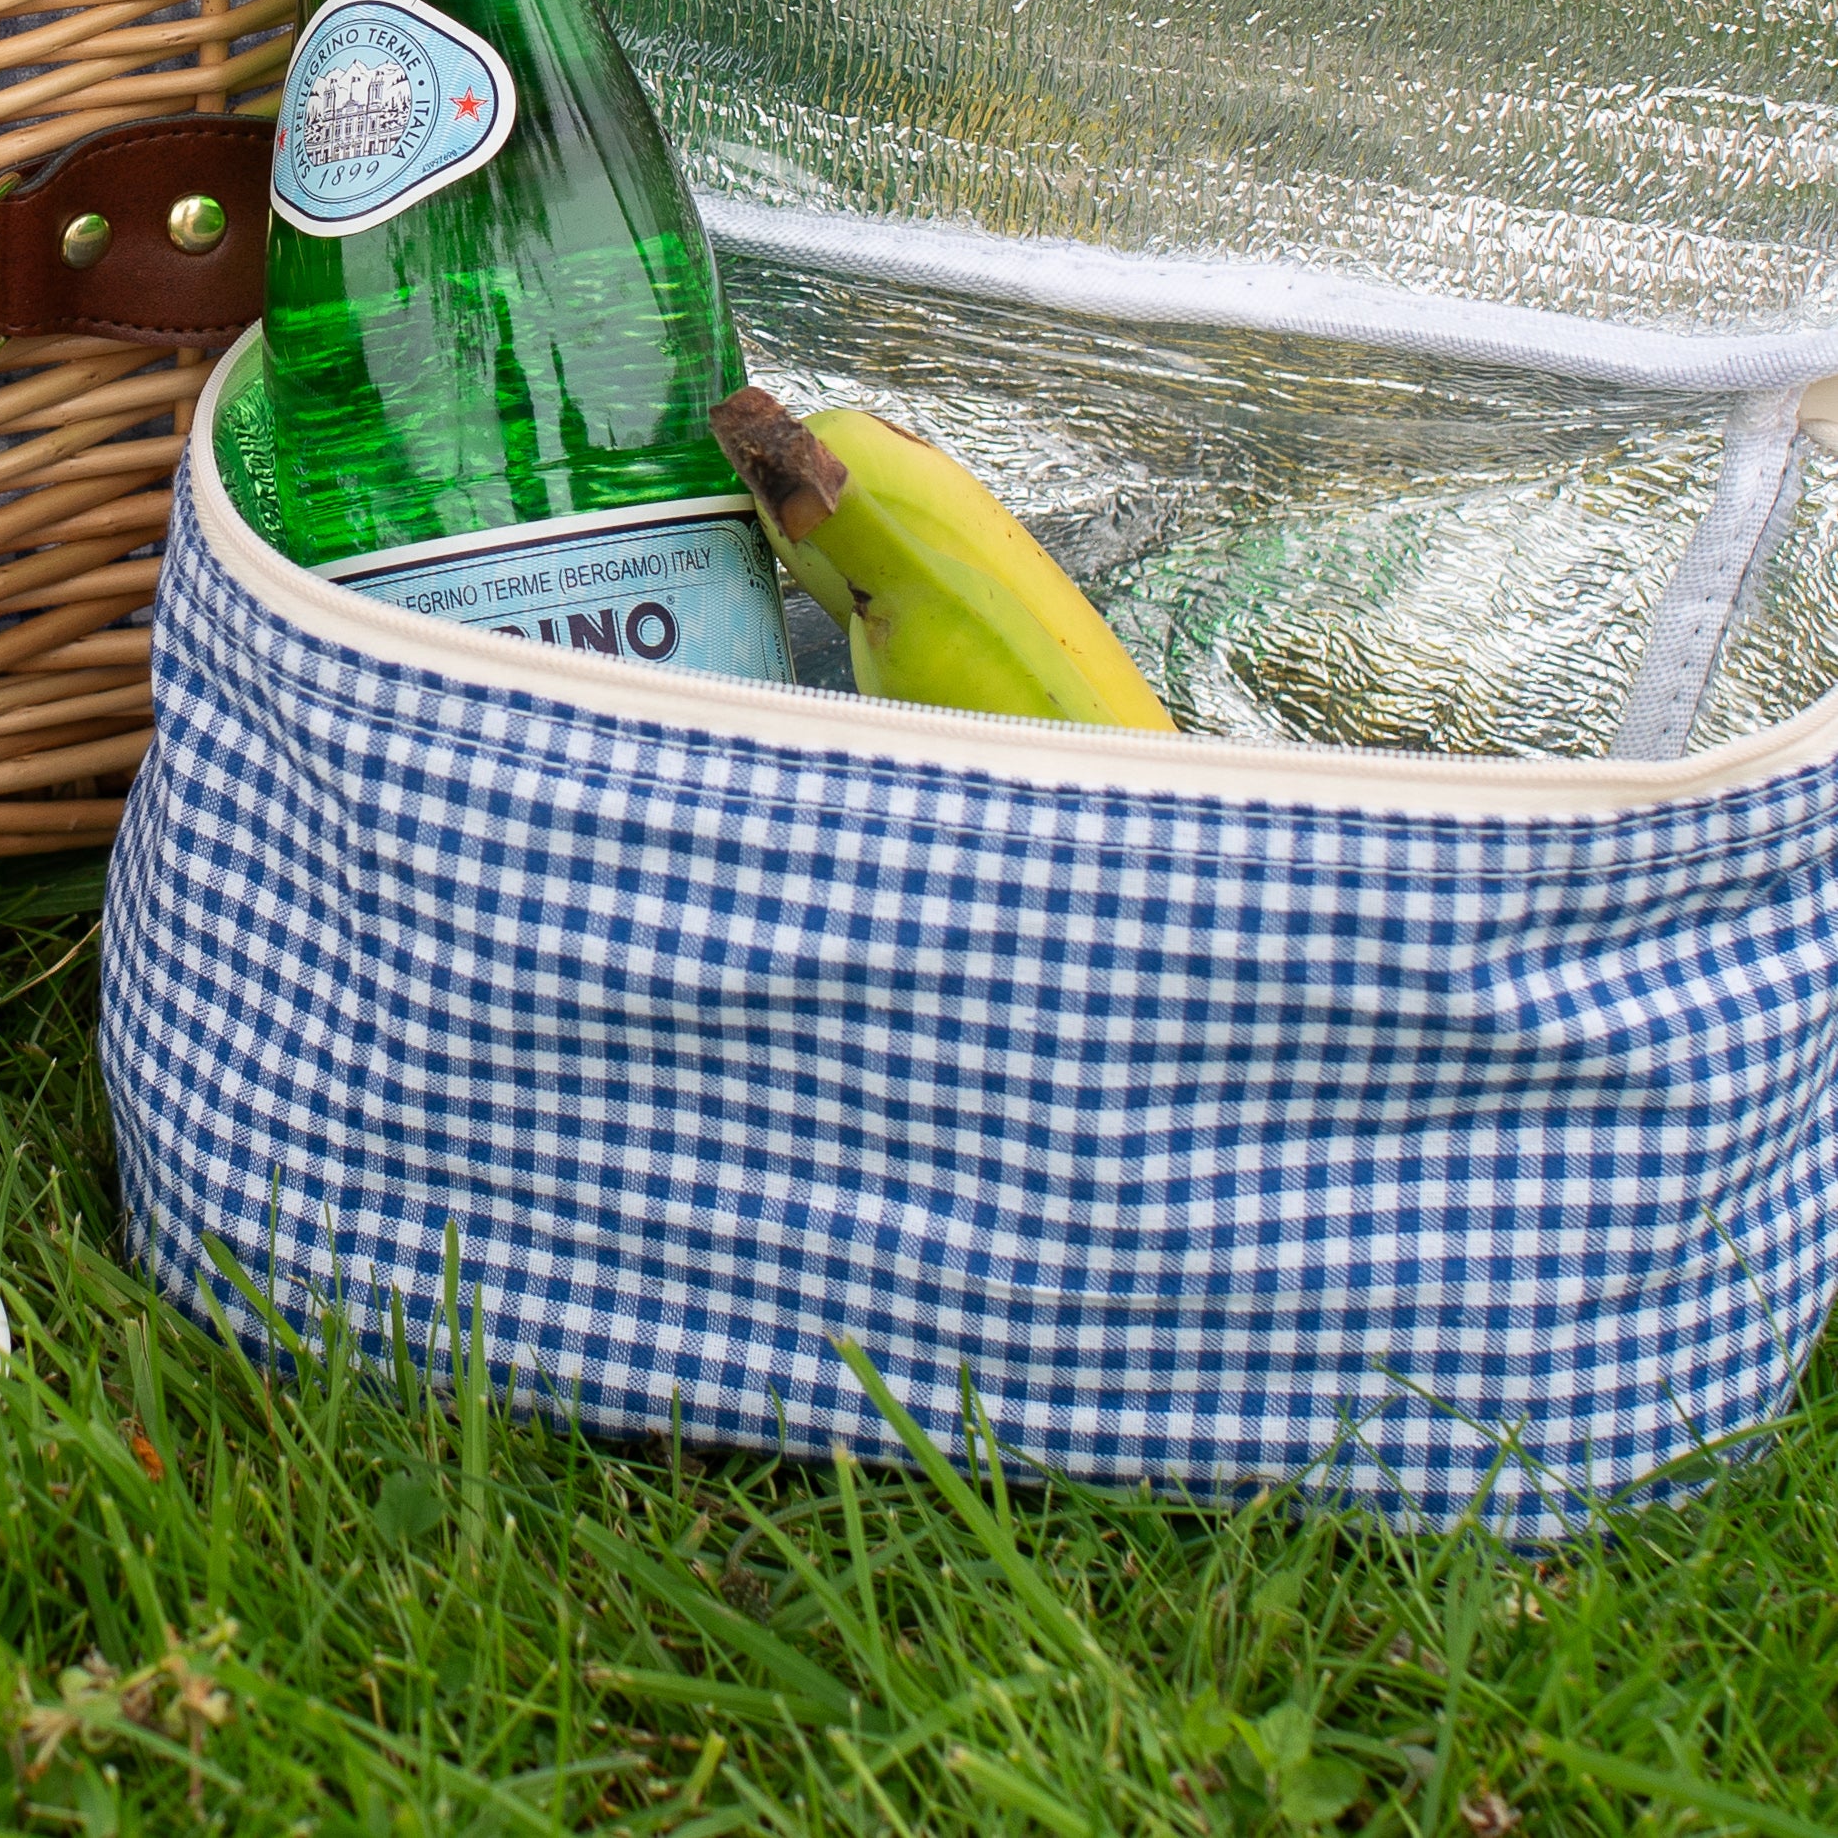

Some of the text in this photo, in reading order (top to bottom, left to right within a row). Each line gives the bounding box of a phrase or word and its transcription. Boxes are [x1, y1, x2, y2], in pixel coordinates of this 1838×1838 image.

[295, 28, 431, 180] SAN PELLEGRINO TERME ITALIA
[319, 159, 380, 189] 1899
[482, 571, 553, 602] TERME
[558, 554, 668, 595] (BERGAMO)
[671, 547, 711, 573] ITALY
[490, 601, 680, 663] INO
